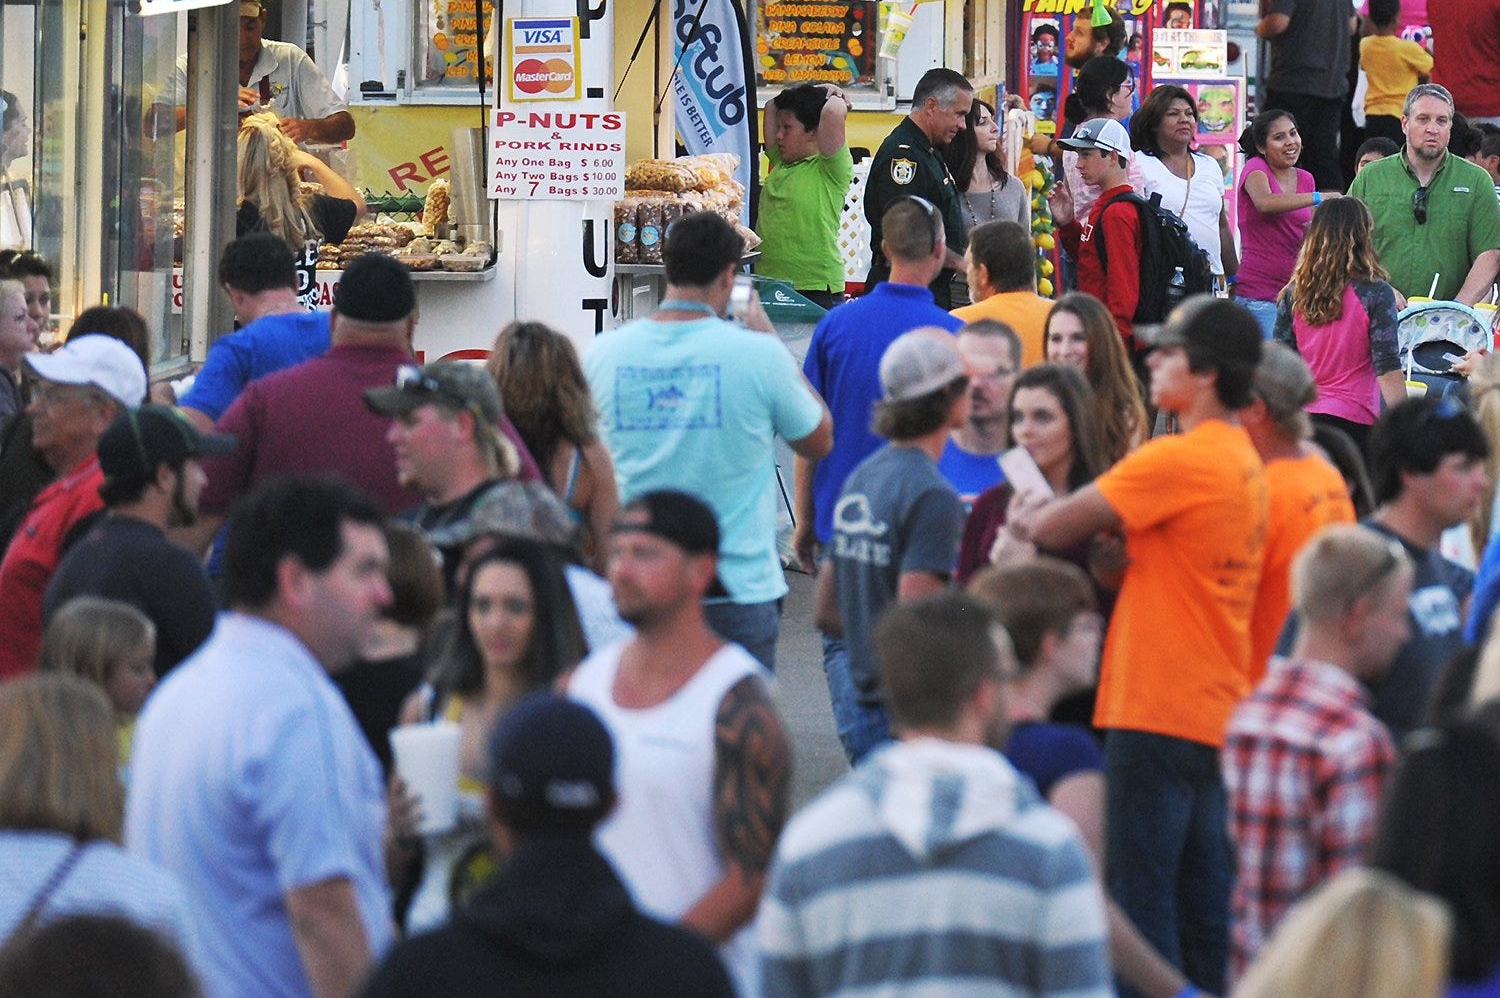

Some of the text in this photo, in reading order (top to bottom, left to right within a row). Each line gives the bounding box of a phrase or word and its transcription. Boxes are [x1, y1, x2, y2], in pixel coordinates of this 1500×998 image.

[523, 29, 563, 44] VISA
[515, 70, 573, 84] MasterCard
[496, 111, 622, 131] P-NUTS
[686, 107, 714, 149] BETTER
[550, 131, 562, 140] &
[495, 140, 622, 152] PORK RINDS
[496, 157, 614, 169] Any One Bag $ 6.00
[495, 171, 617, 183] Any Two Bags $ 10.00
[495, 181, 618, 197] Any 7 Bags $ 30.00
